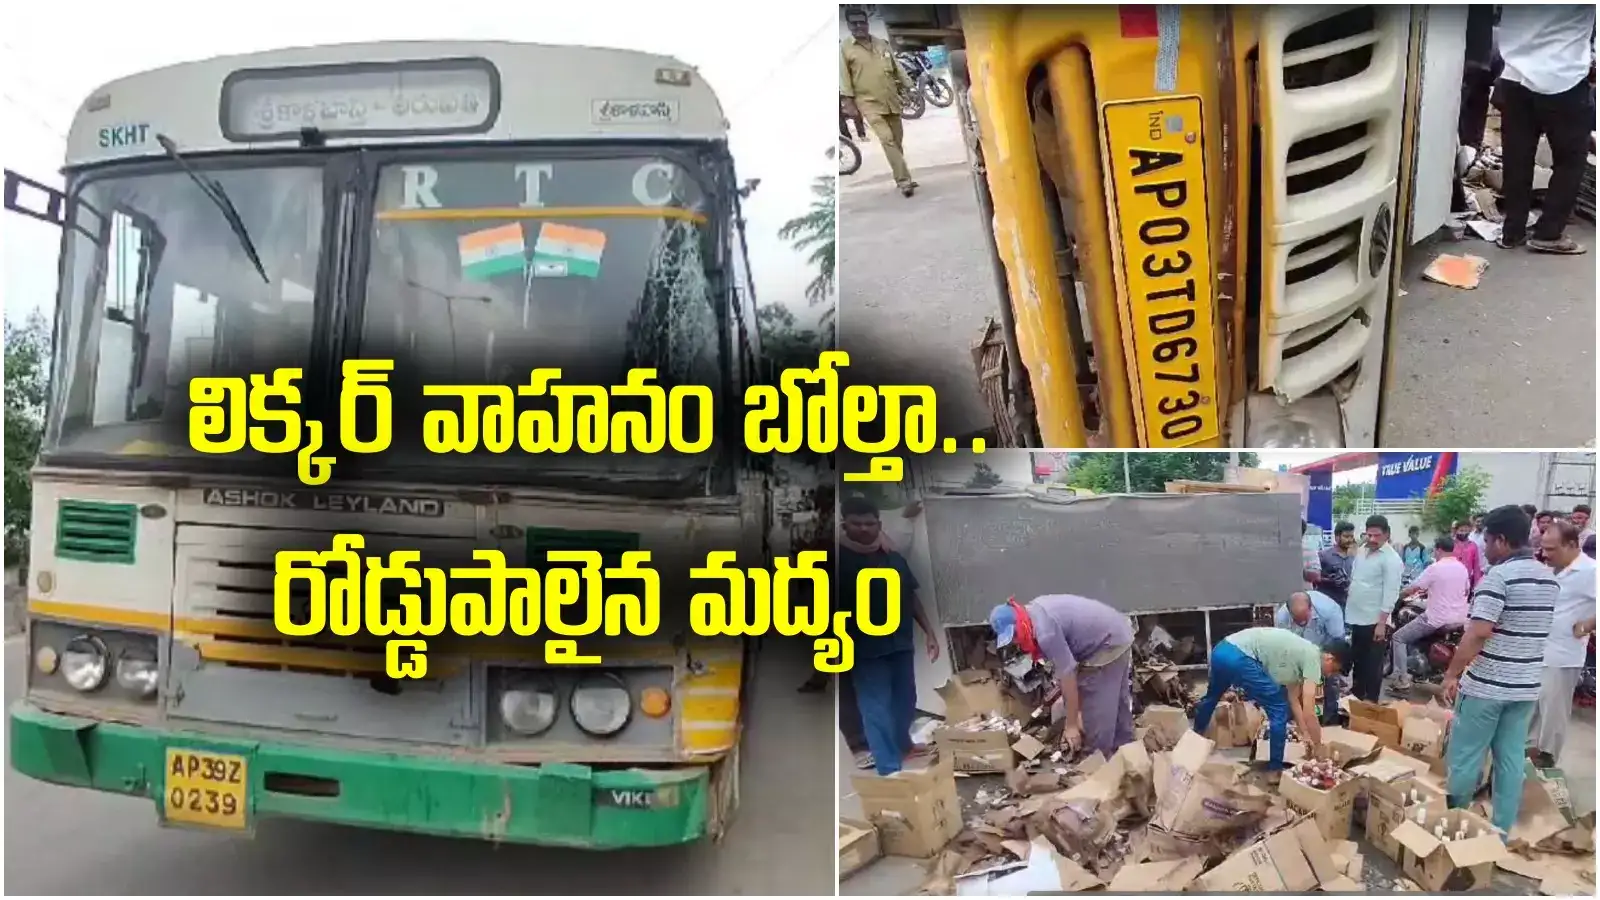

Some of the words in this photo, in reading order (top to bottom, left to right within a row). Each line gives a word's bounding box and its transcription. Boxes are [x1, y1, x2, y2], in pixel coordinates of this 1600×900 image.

[98, 124, 150, 148] SKHT
[1149, 110, 1164, 141] IND
[1128, 148, 1204, 441] AP03TD6730
[1381, 461, 1402, 477] TRUE
[1403, 454, 1433, 473] VALUE
[206, 489, 297, 508] ASHOK
[313, 495, 441, 515] LEYLAND
[171, 753, 242, 784] AP39Z
[170, 786, 238, 816] 0239
